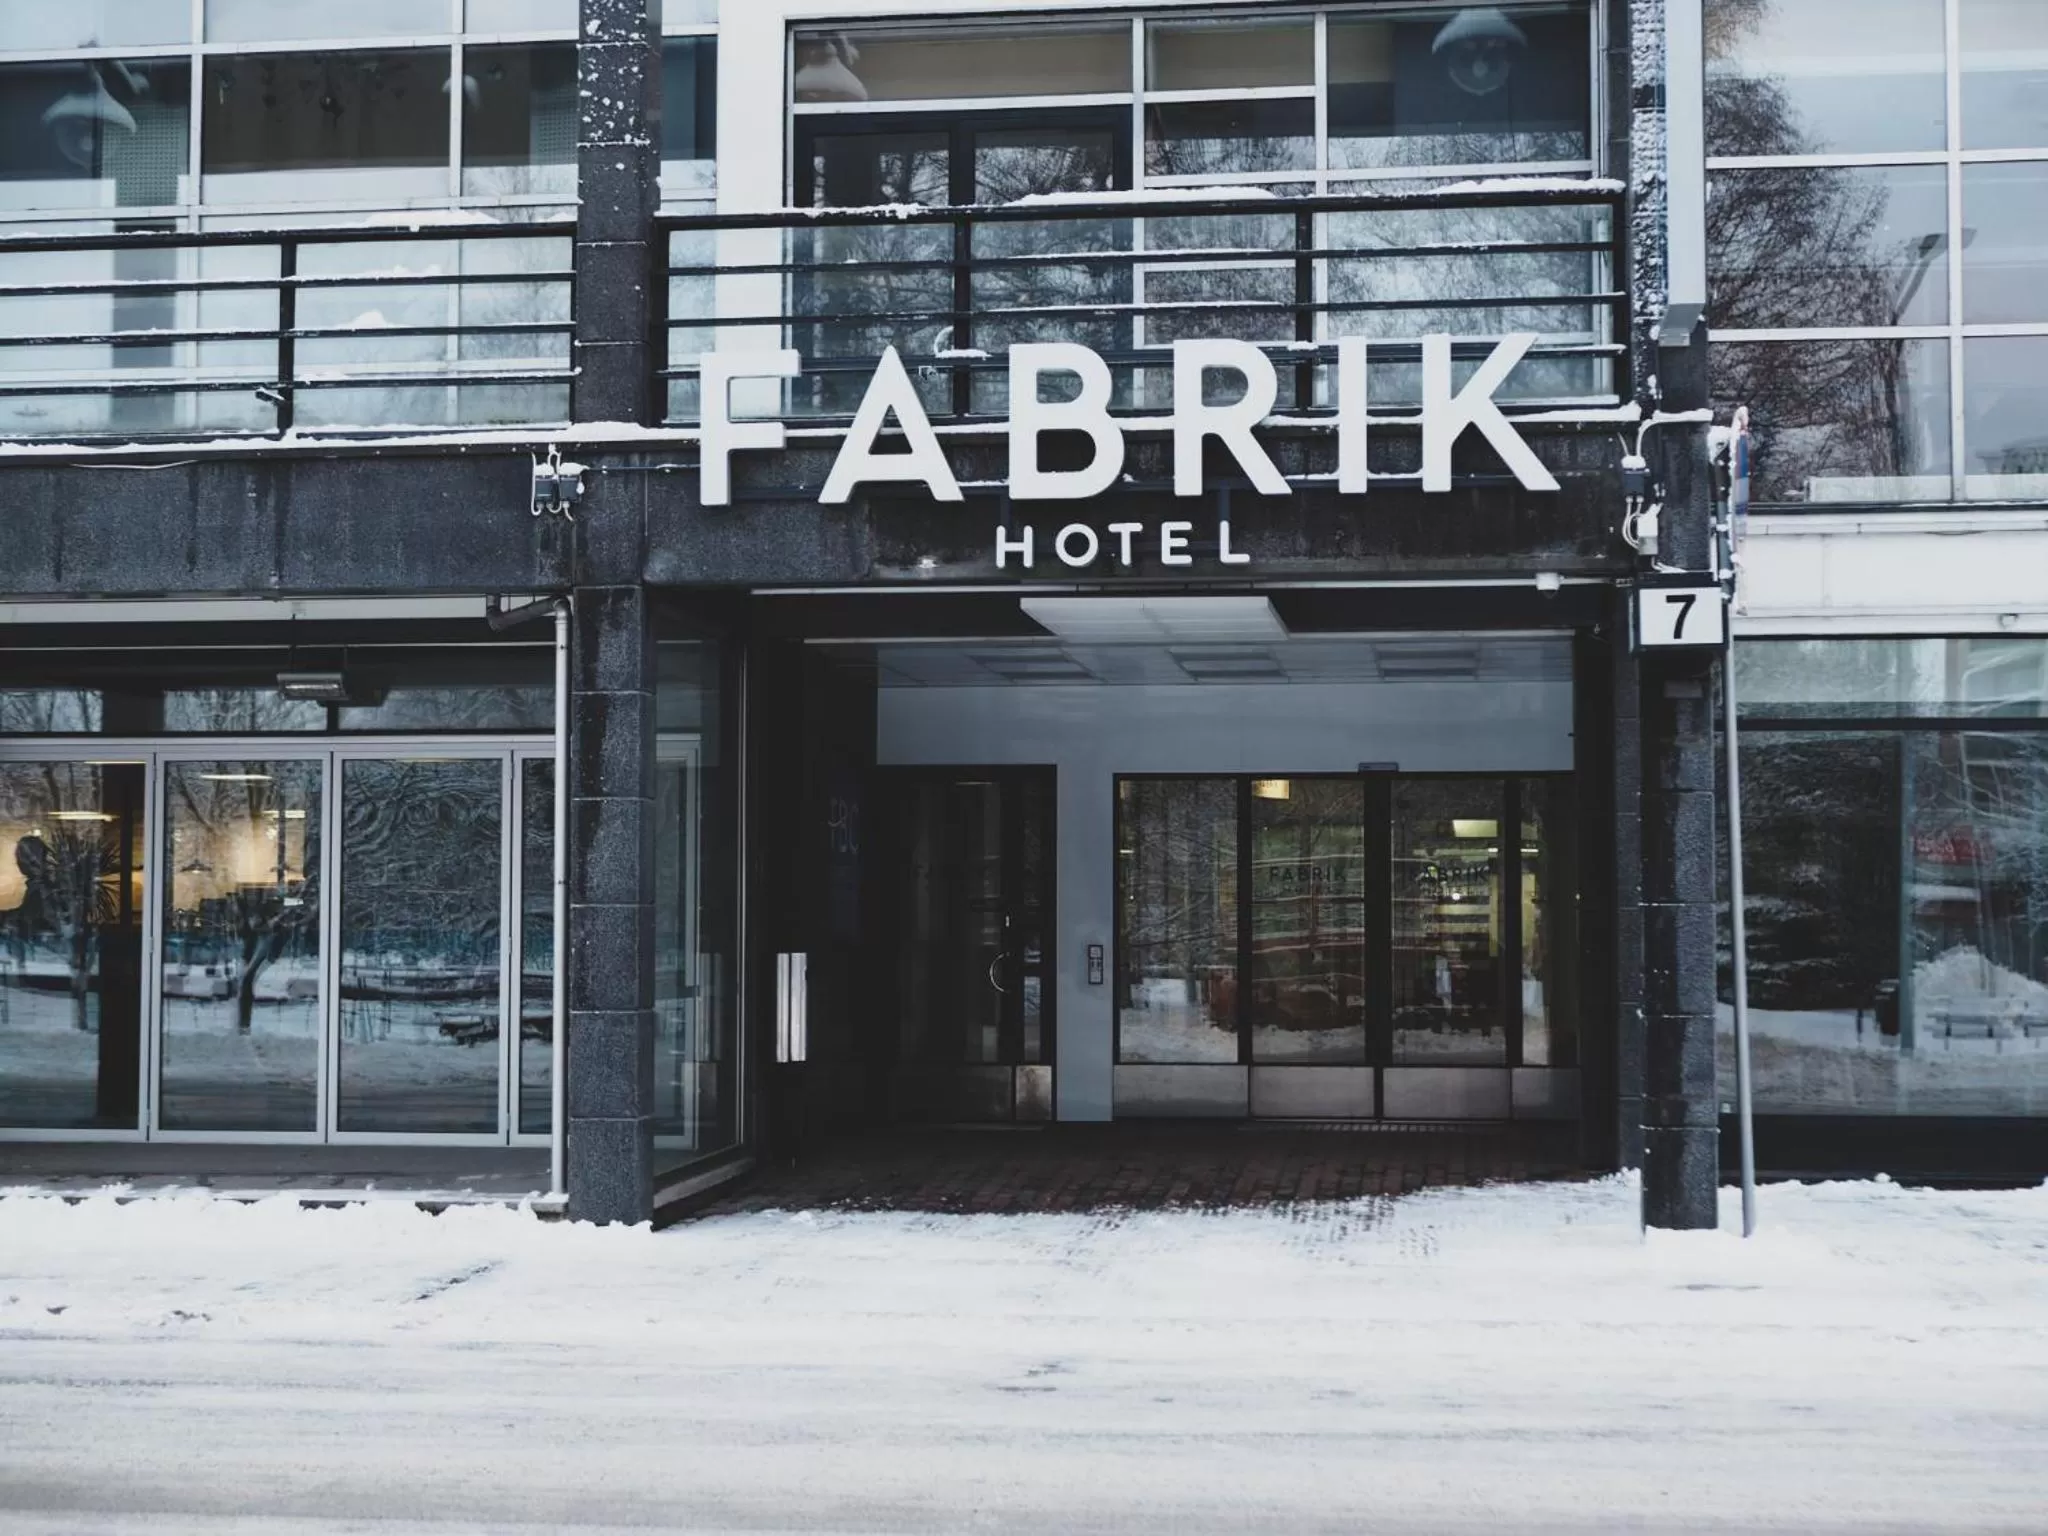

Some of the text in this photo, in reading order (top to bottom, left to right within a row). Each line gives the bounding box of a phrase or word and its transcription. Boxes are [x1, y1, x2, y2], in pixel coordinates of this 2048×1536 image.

[698, 332, 1561, 506] FABRIK
[996, 519, 1251, 569] HOTEL
[1665, 593, 1697, 640] 7
